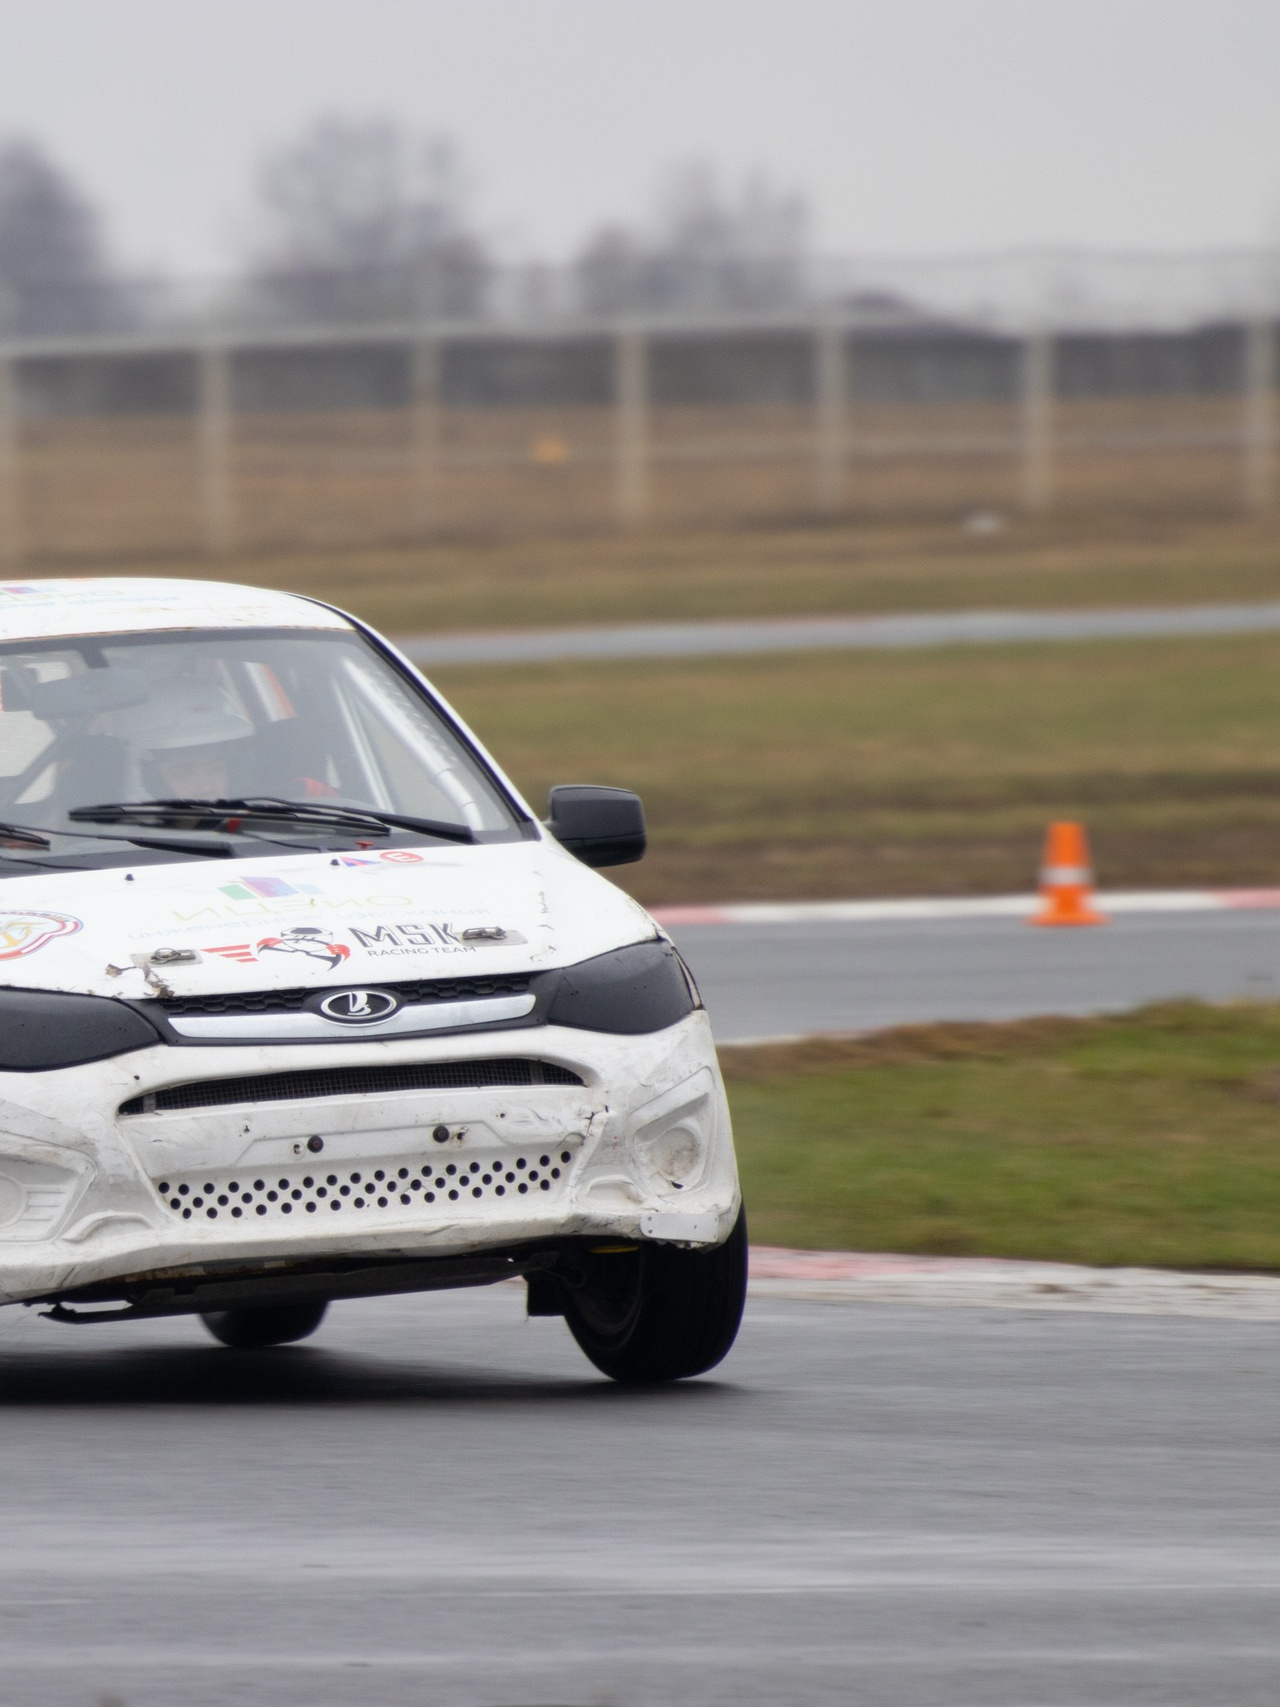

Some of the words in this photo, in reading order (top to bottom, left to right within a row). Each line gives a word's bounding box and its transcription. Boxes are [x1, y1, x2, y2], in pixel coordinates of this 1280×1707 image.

[348, 922, 461, 948] MSK
[368, 947, 429, 957] RACING
[432, 946, 477, 955] TEAM
